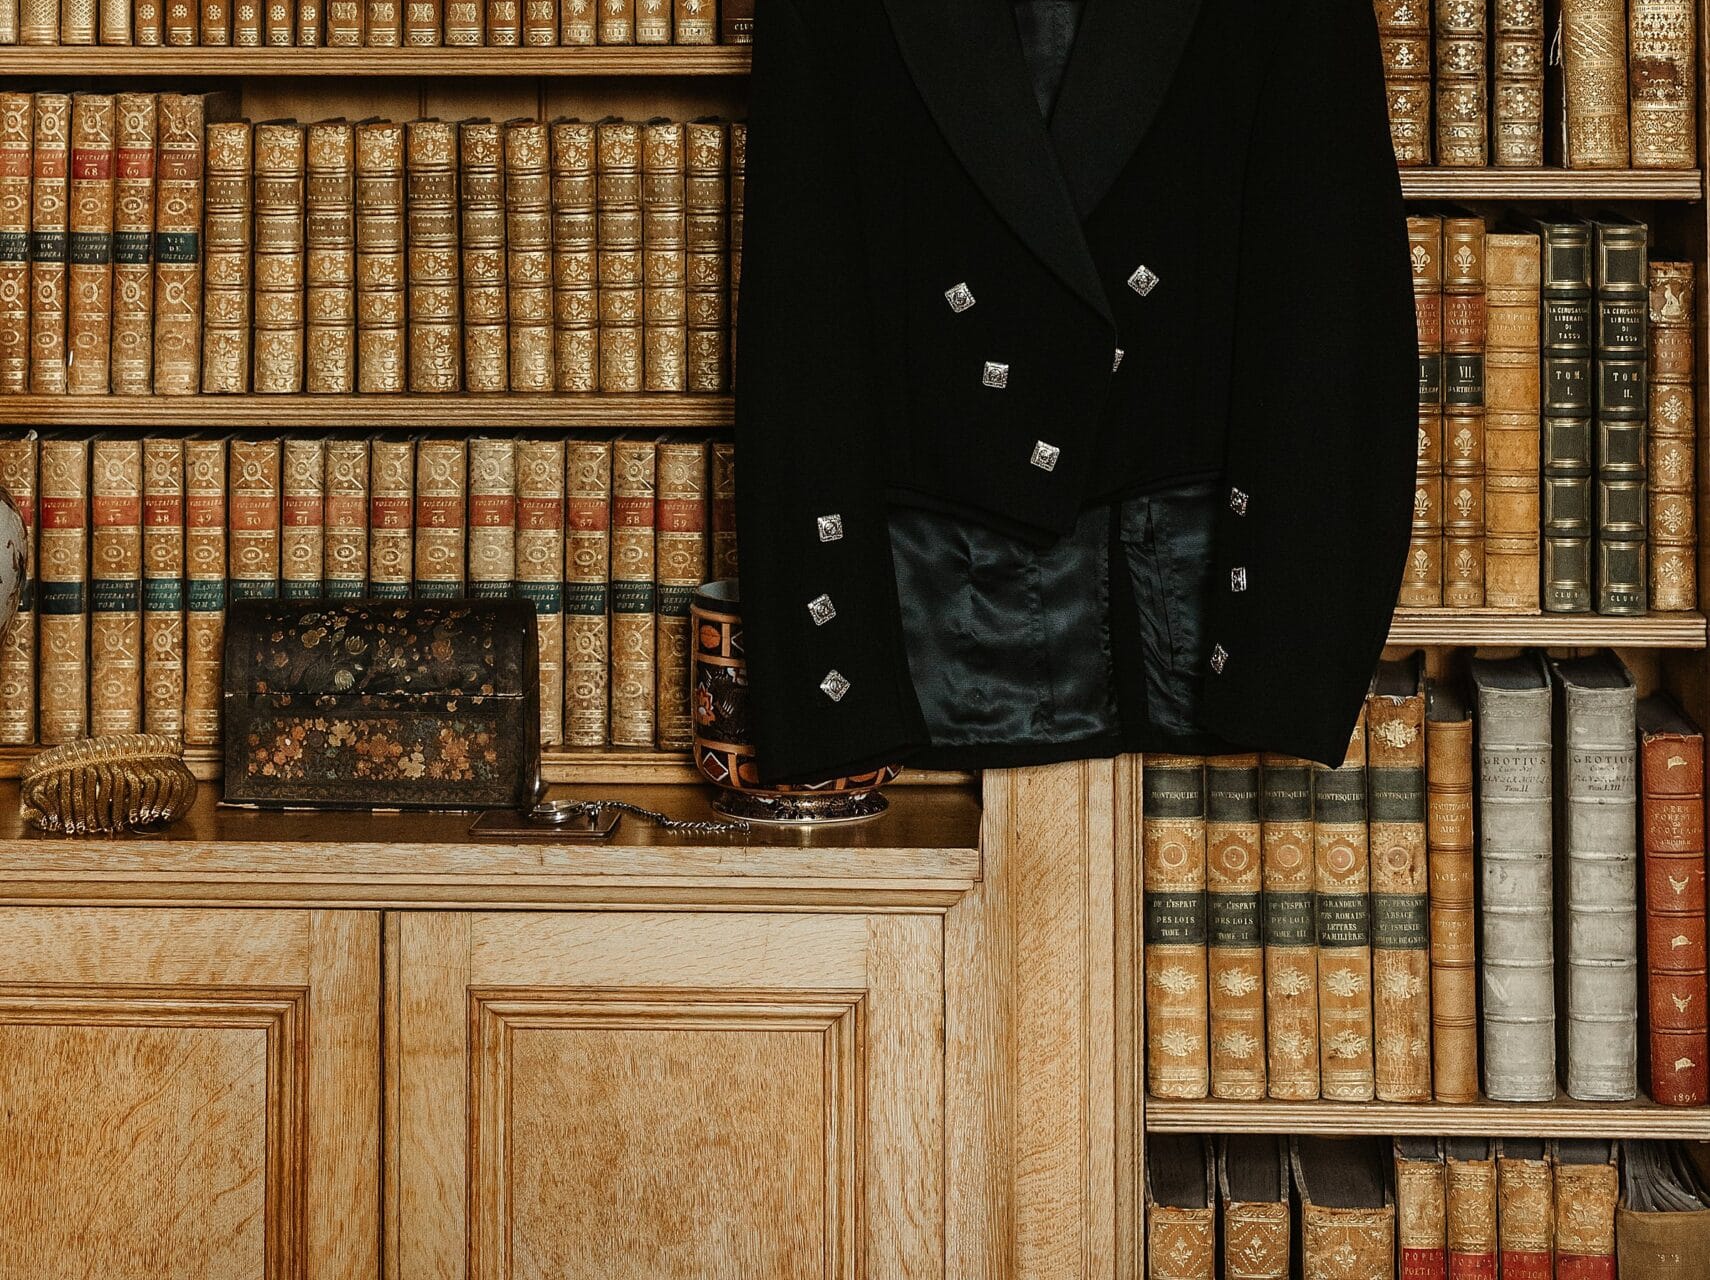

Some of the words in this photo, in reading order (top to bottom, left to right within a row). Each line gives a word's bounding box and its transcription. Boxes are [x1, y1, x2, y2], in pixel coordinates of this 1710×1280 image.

[485, 515, 500, 523] 55
[1483, 757, 1546, 766] GROTIUS
[1574, 755, 1634, 763] GROTIUS
